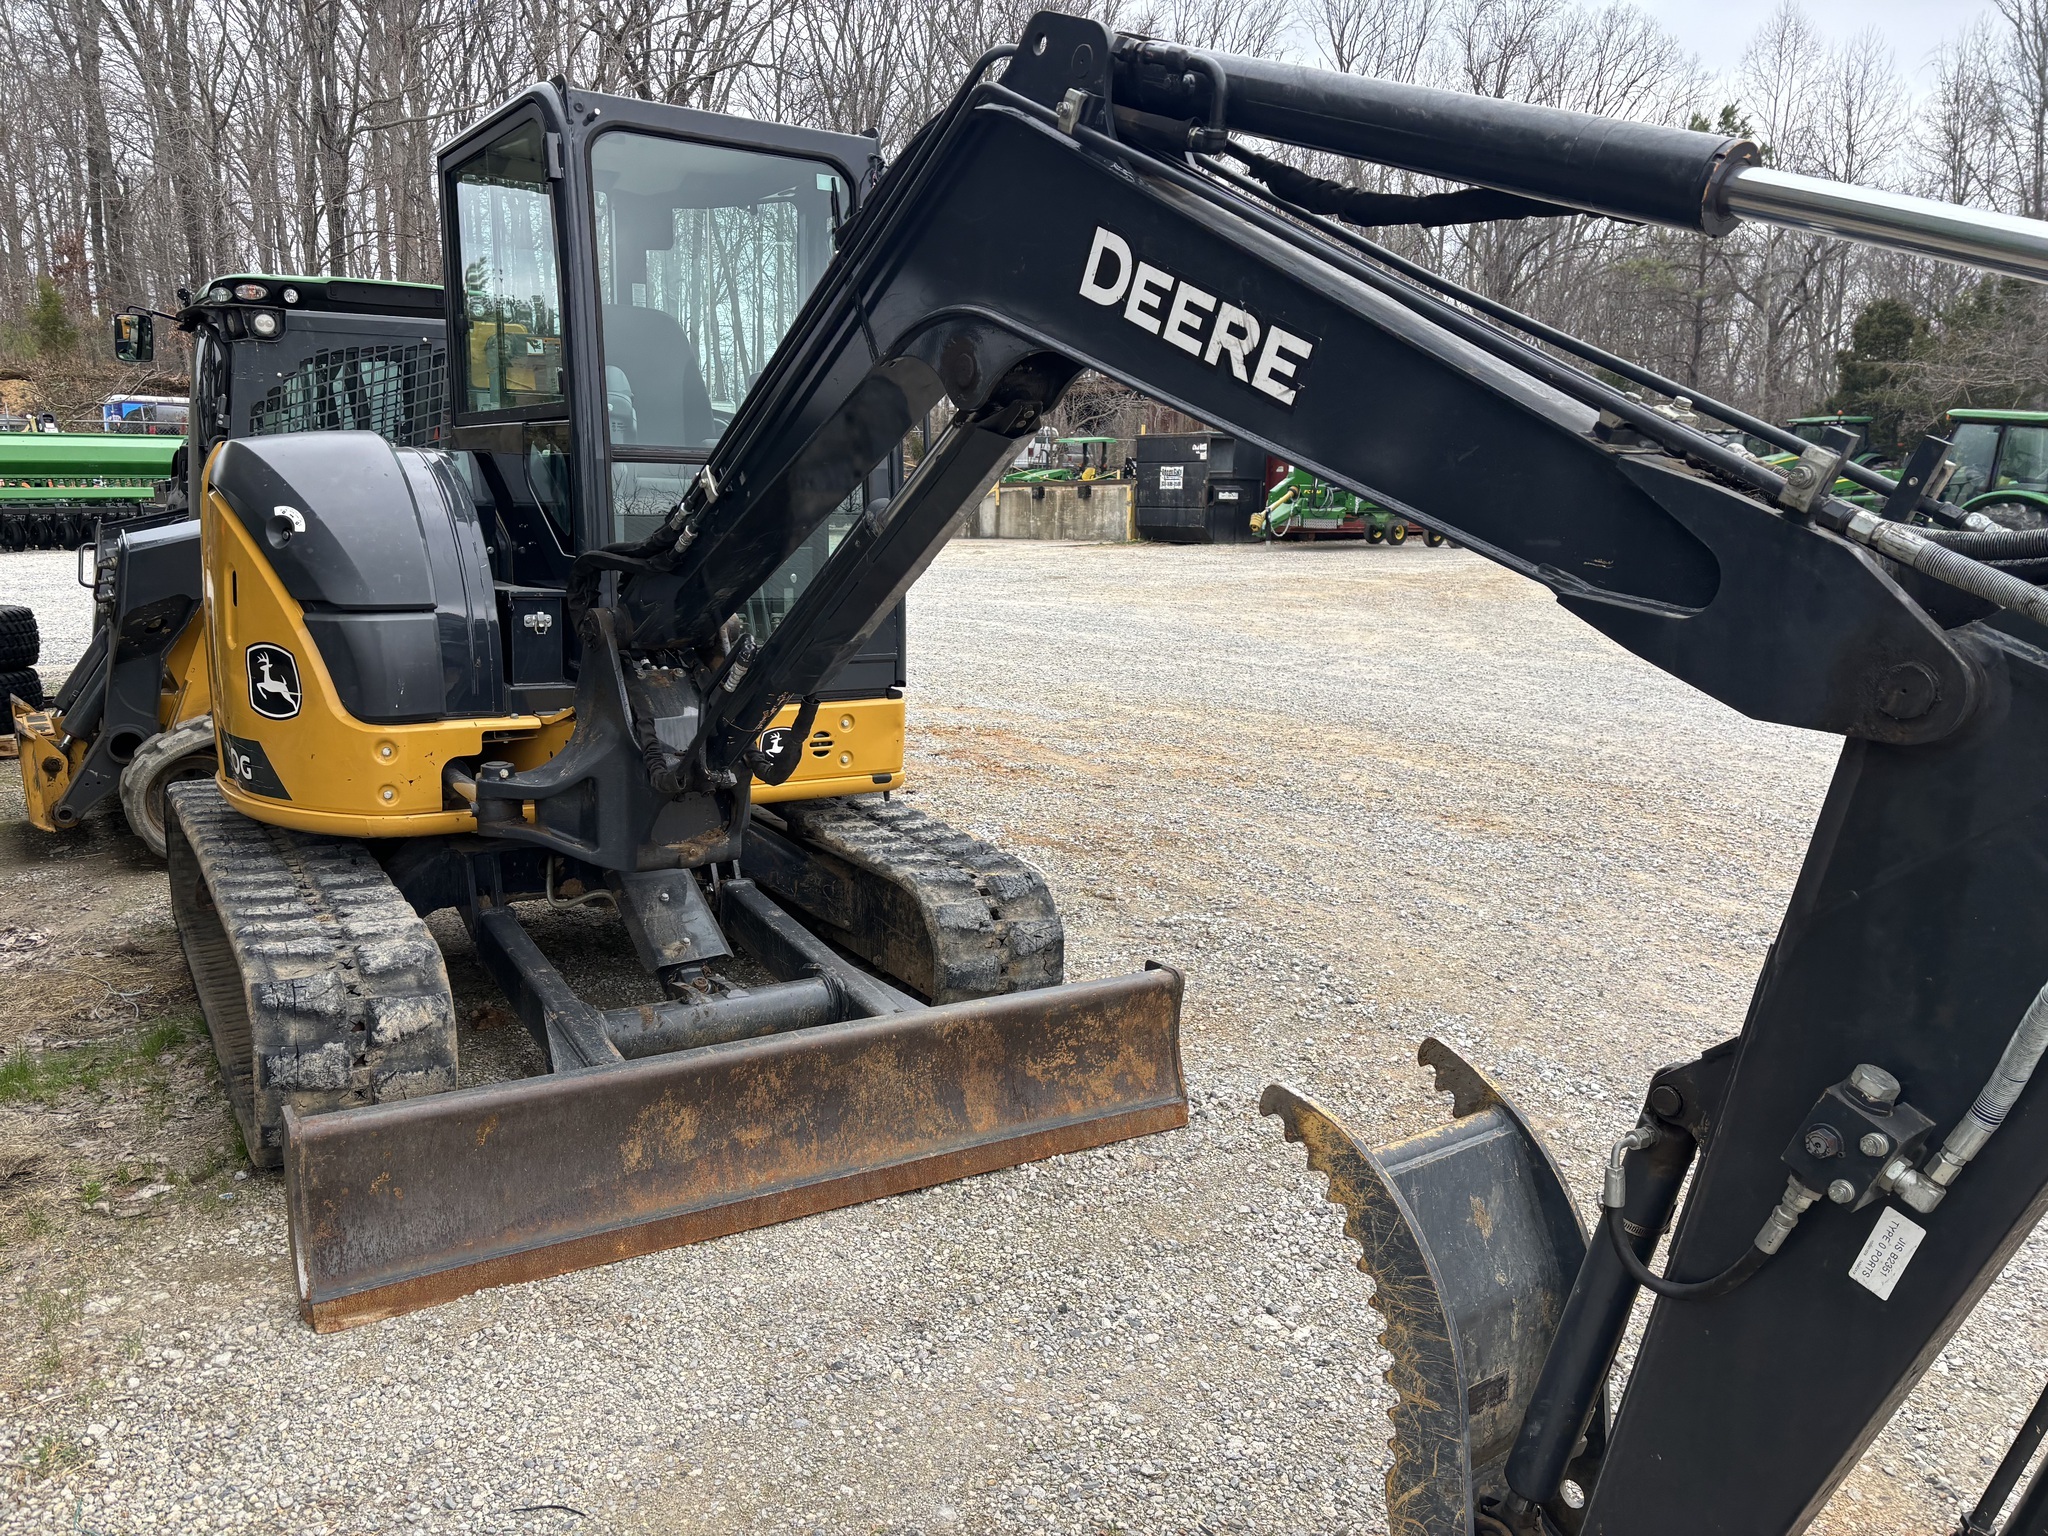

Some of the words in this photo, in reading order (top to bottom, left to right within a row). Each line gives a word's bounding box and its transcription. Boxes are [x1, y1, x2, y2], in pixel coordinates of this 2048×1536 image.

[1079, 226, 1313, 406] DEERE
[1881, 1220, 1900, 1243] TYPE
[1894, 1237, 1906, 1252] JIS
[1861, 1248, 1883, 1278] PORTS
[1880, 1252, 1899, 1278] B2351
